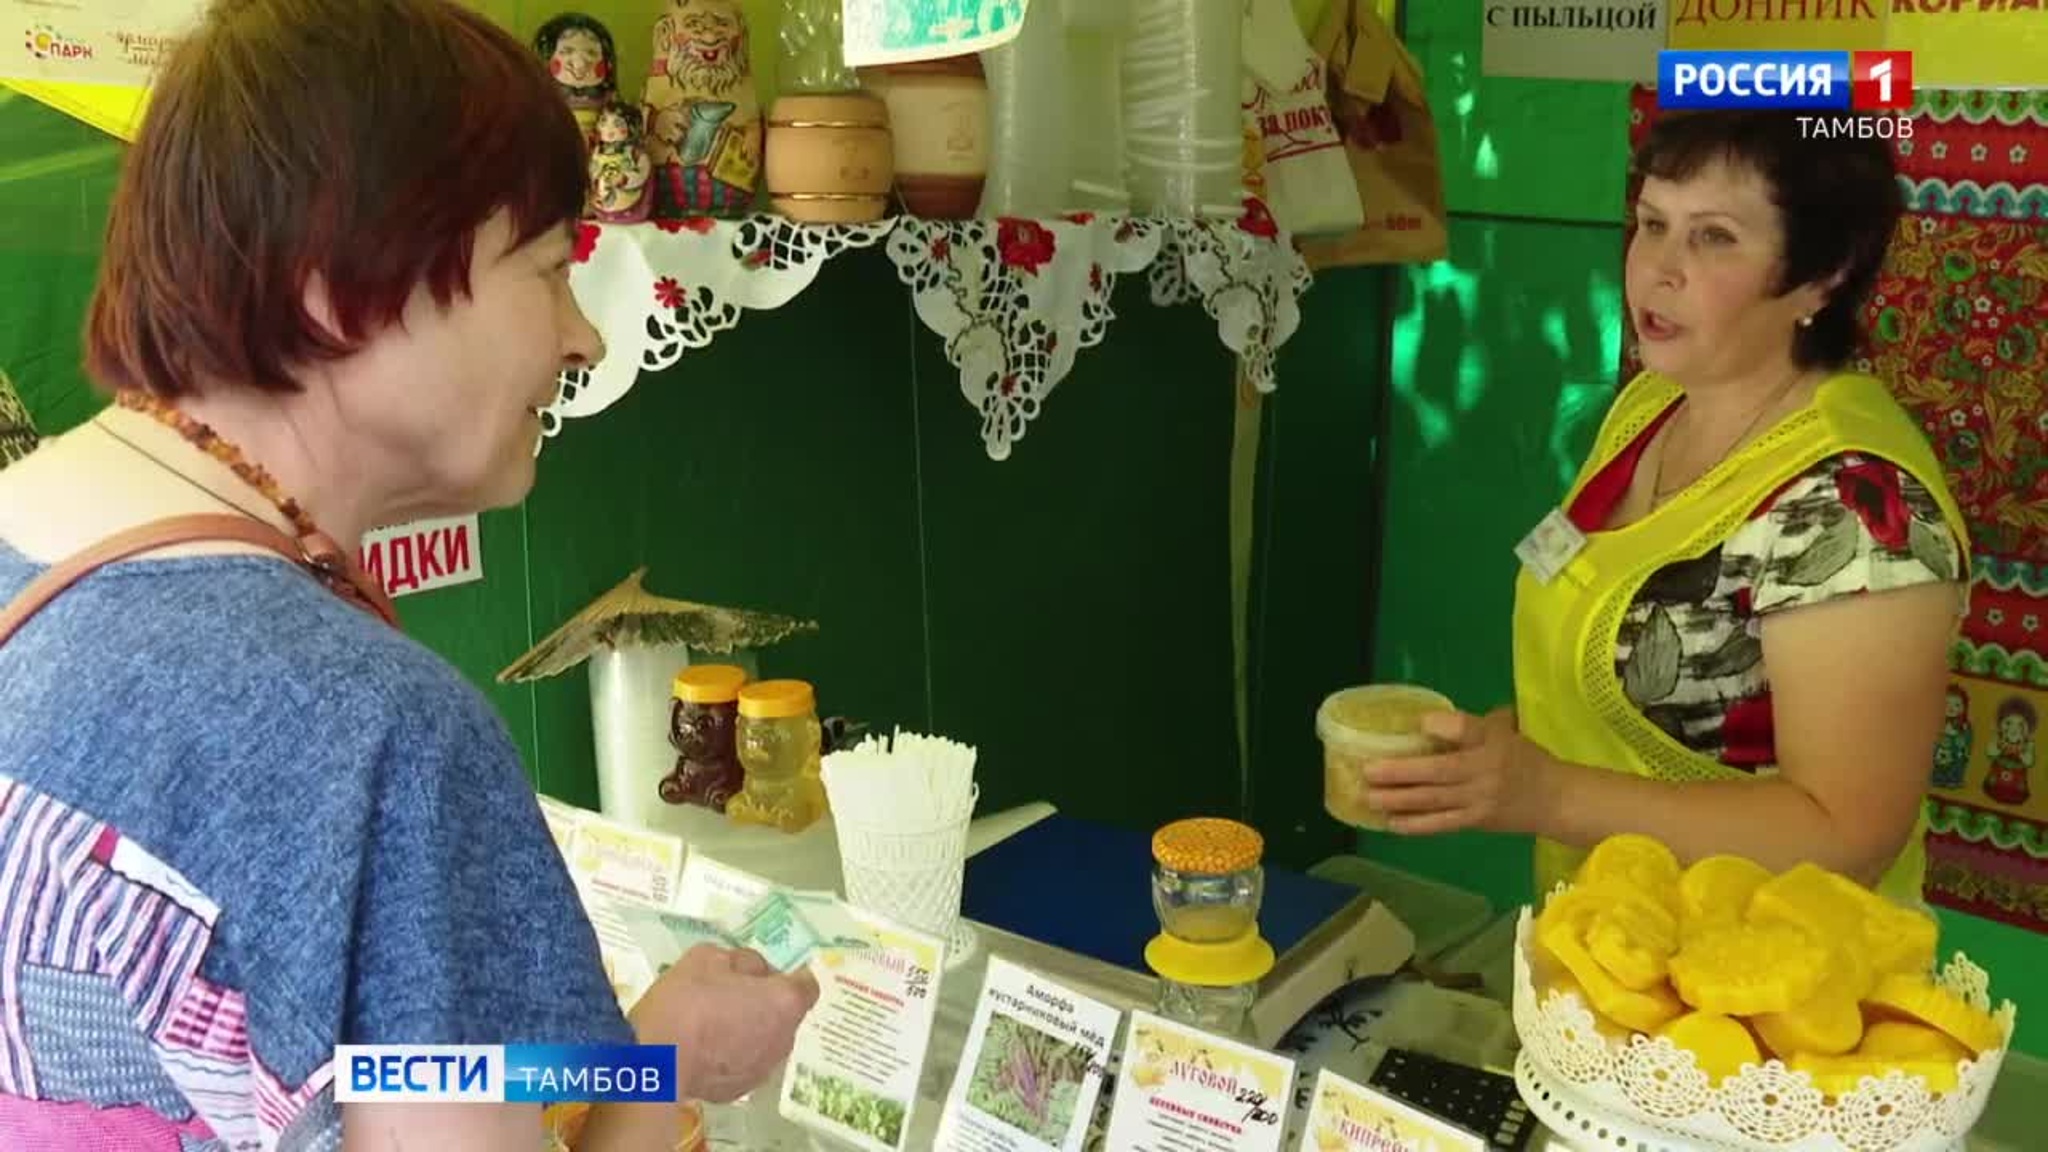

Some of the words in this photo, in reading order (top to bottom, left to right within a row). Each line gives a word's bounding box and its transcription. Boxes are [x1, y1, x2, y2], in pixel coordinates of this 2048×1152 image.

[1486, 6, 1505, 27] С
[1512, 2, 1657, 31] ПЫЛЬЦОЙ
[1676, 0, 1876, 27] ДОННИК
[1892, 0, 2048, 14] КОРИА
[1026, 985, 1075, 1013] Аморфа
[1079, 1027, 1106, 1048] мёд
[1170, 1061, 1239, 1096] ЛУГОВОЙ
